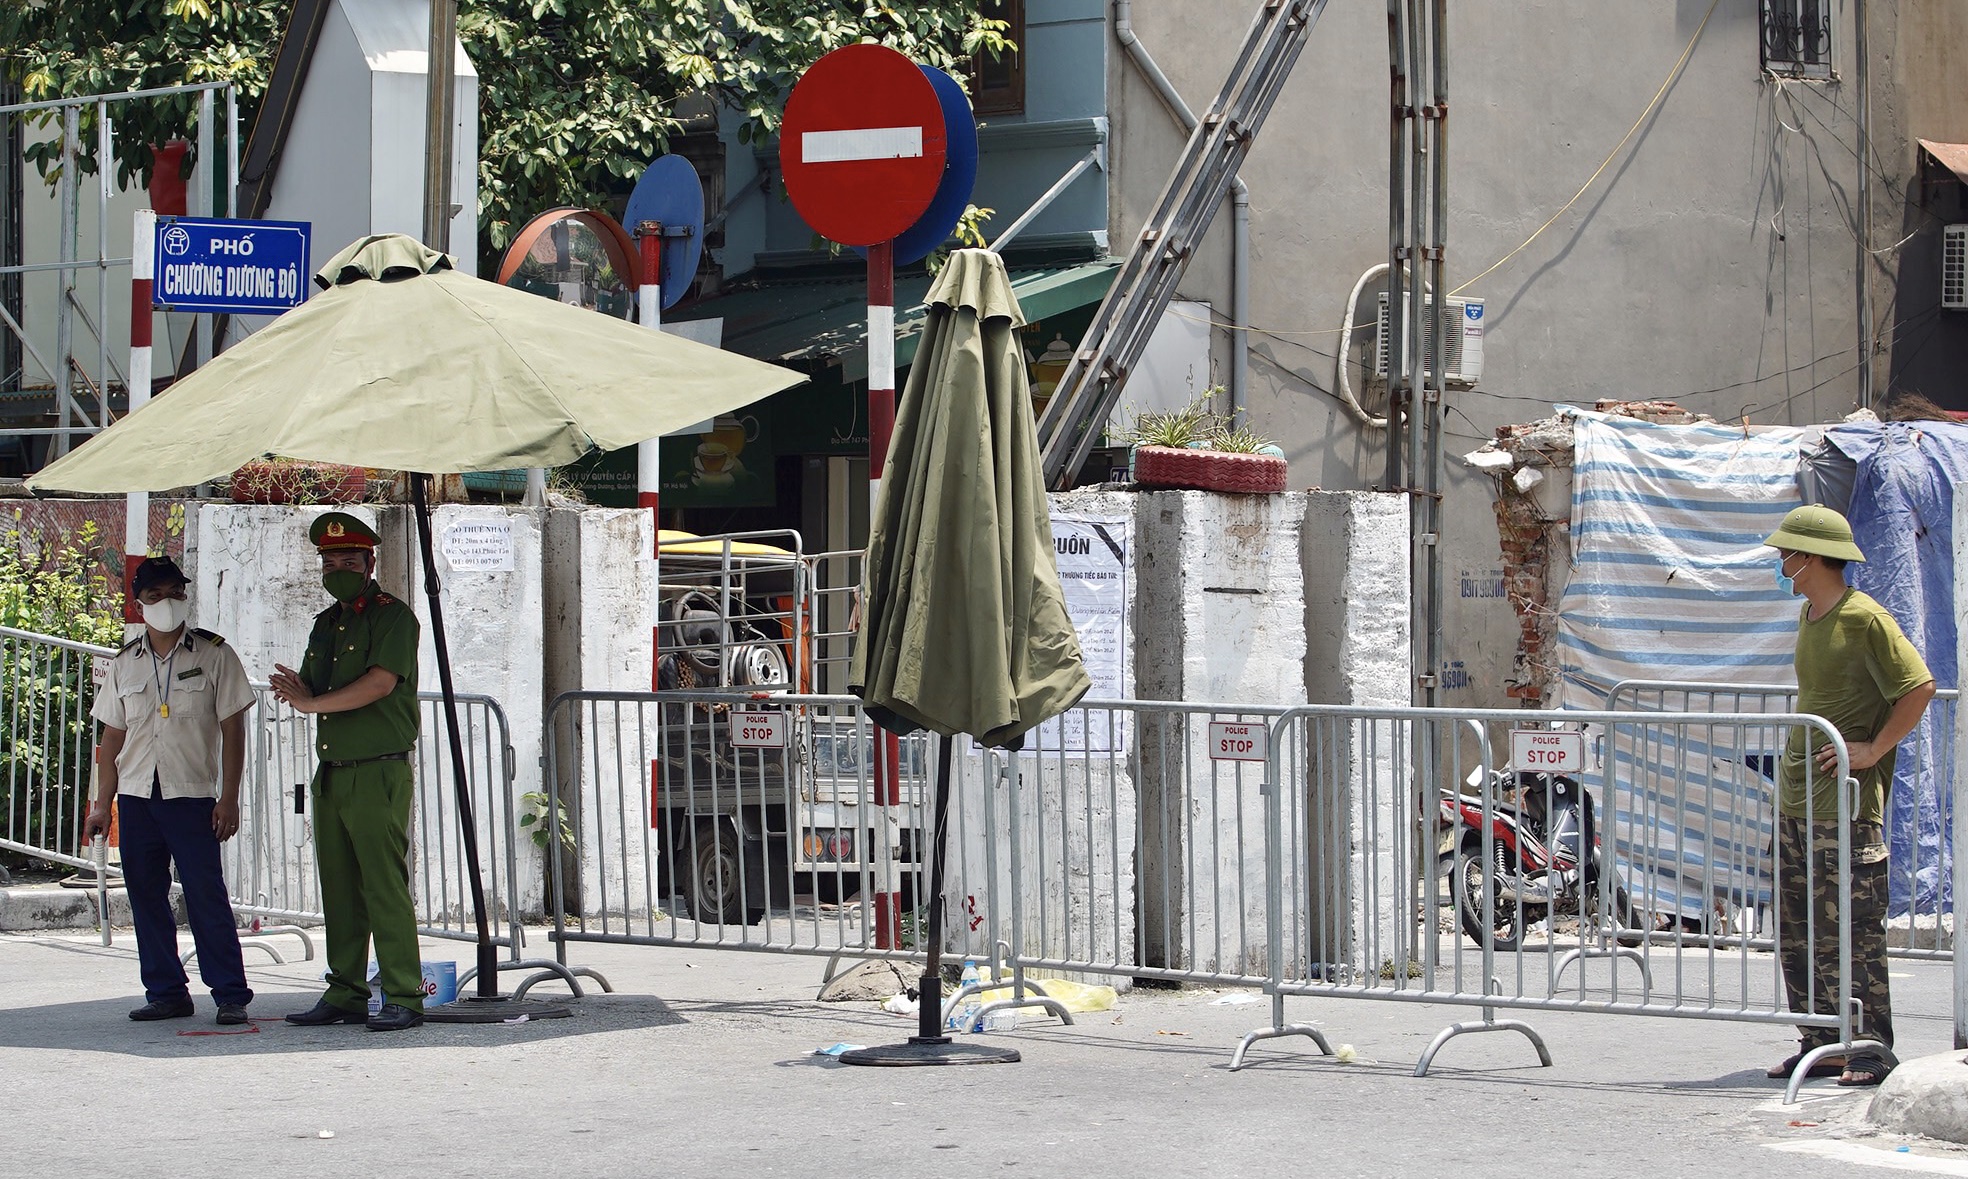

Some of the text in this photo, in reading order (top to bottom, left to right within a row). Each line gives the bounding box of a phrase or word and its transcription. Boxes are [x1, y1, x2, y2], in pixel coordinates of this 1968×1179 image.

[210, 233, 255, 255] PHỐ
[165, 262, 297, 305] CHƯƠNG DƯƠNG ĐỘ
[616, 470, 632, 480] CẤP
[1112, 471, 1127, 482] 74
[95, 666, 108, 678] DỪN
[743, 728, 772, 740] STOP
[1221, 739, 1253, 752] STOP
[1528, 750, 1566, 763] STOP
